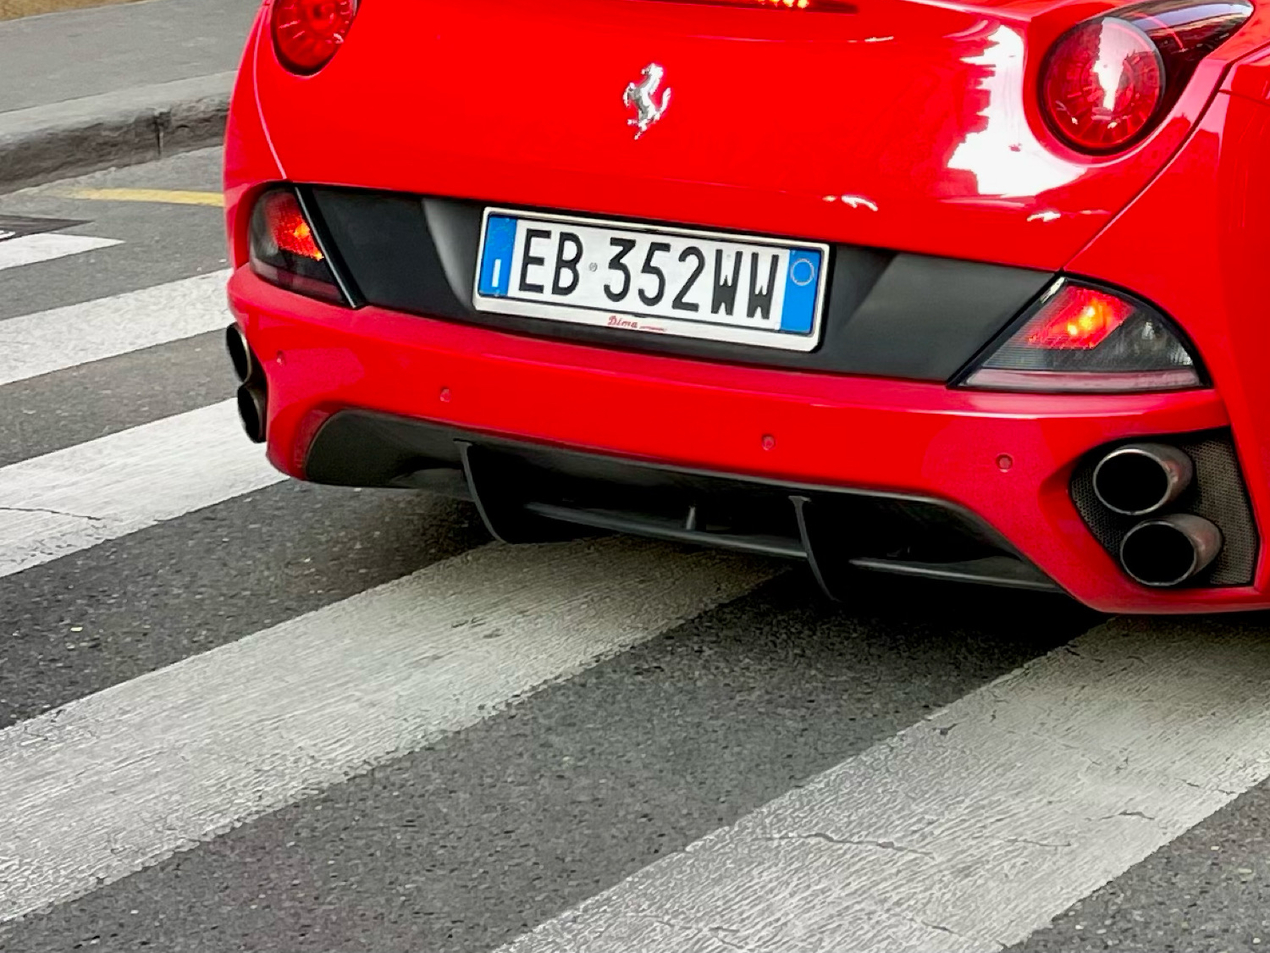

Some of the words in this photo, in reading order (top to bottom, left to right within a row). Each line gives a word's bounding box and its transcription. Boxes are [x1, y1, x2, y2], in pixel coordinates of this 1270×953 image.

[518, 228, 584, 297] EB
[603, 236, 780, 321] 352WW
[607, 315, 639, 329] Dima
